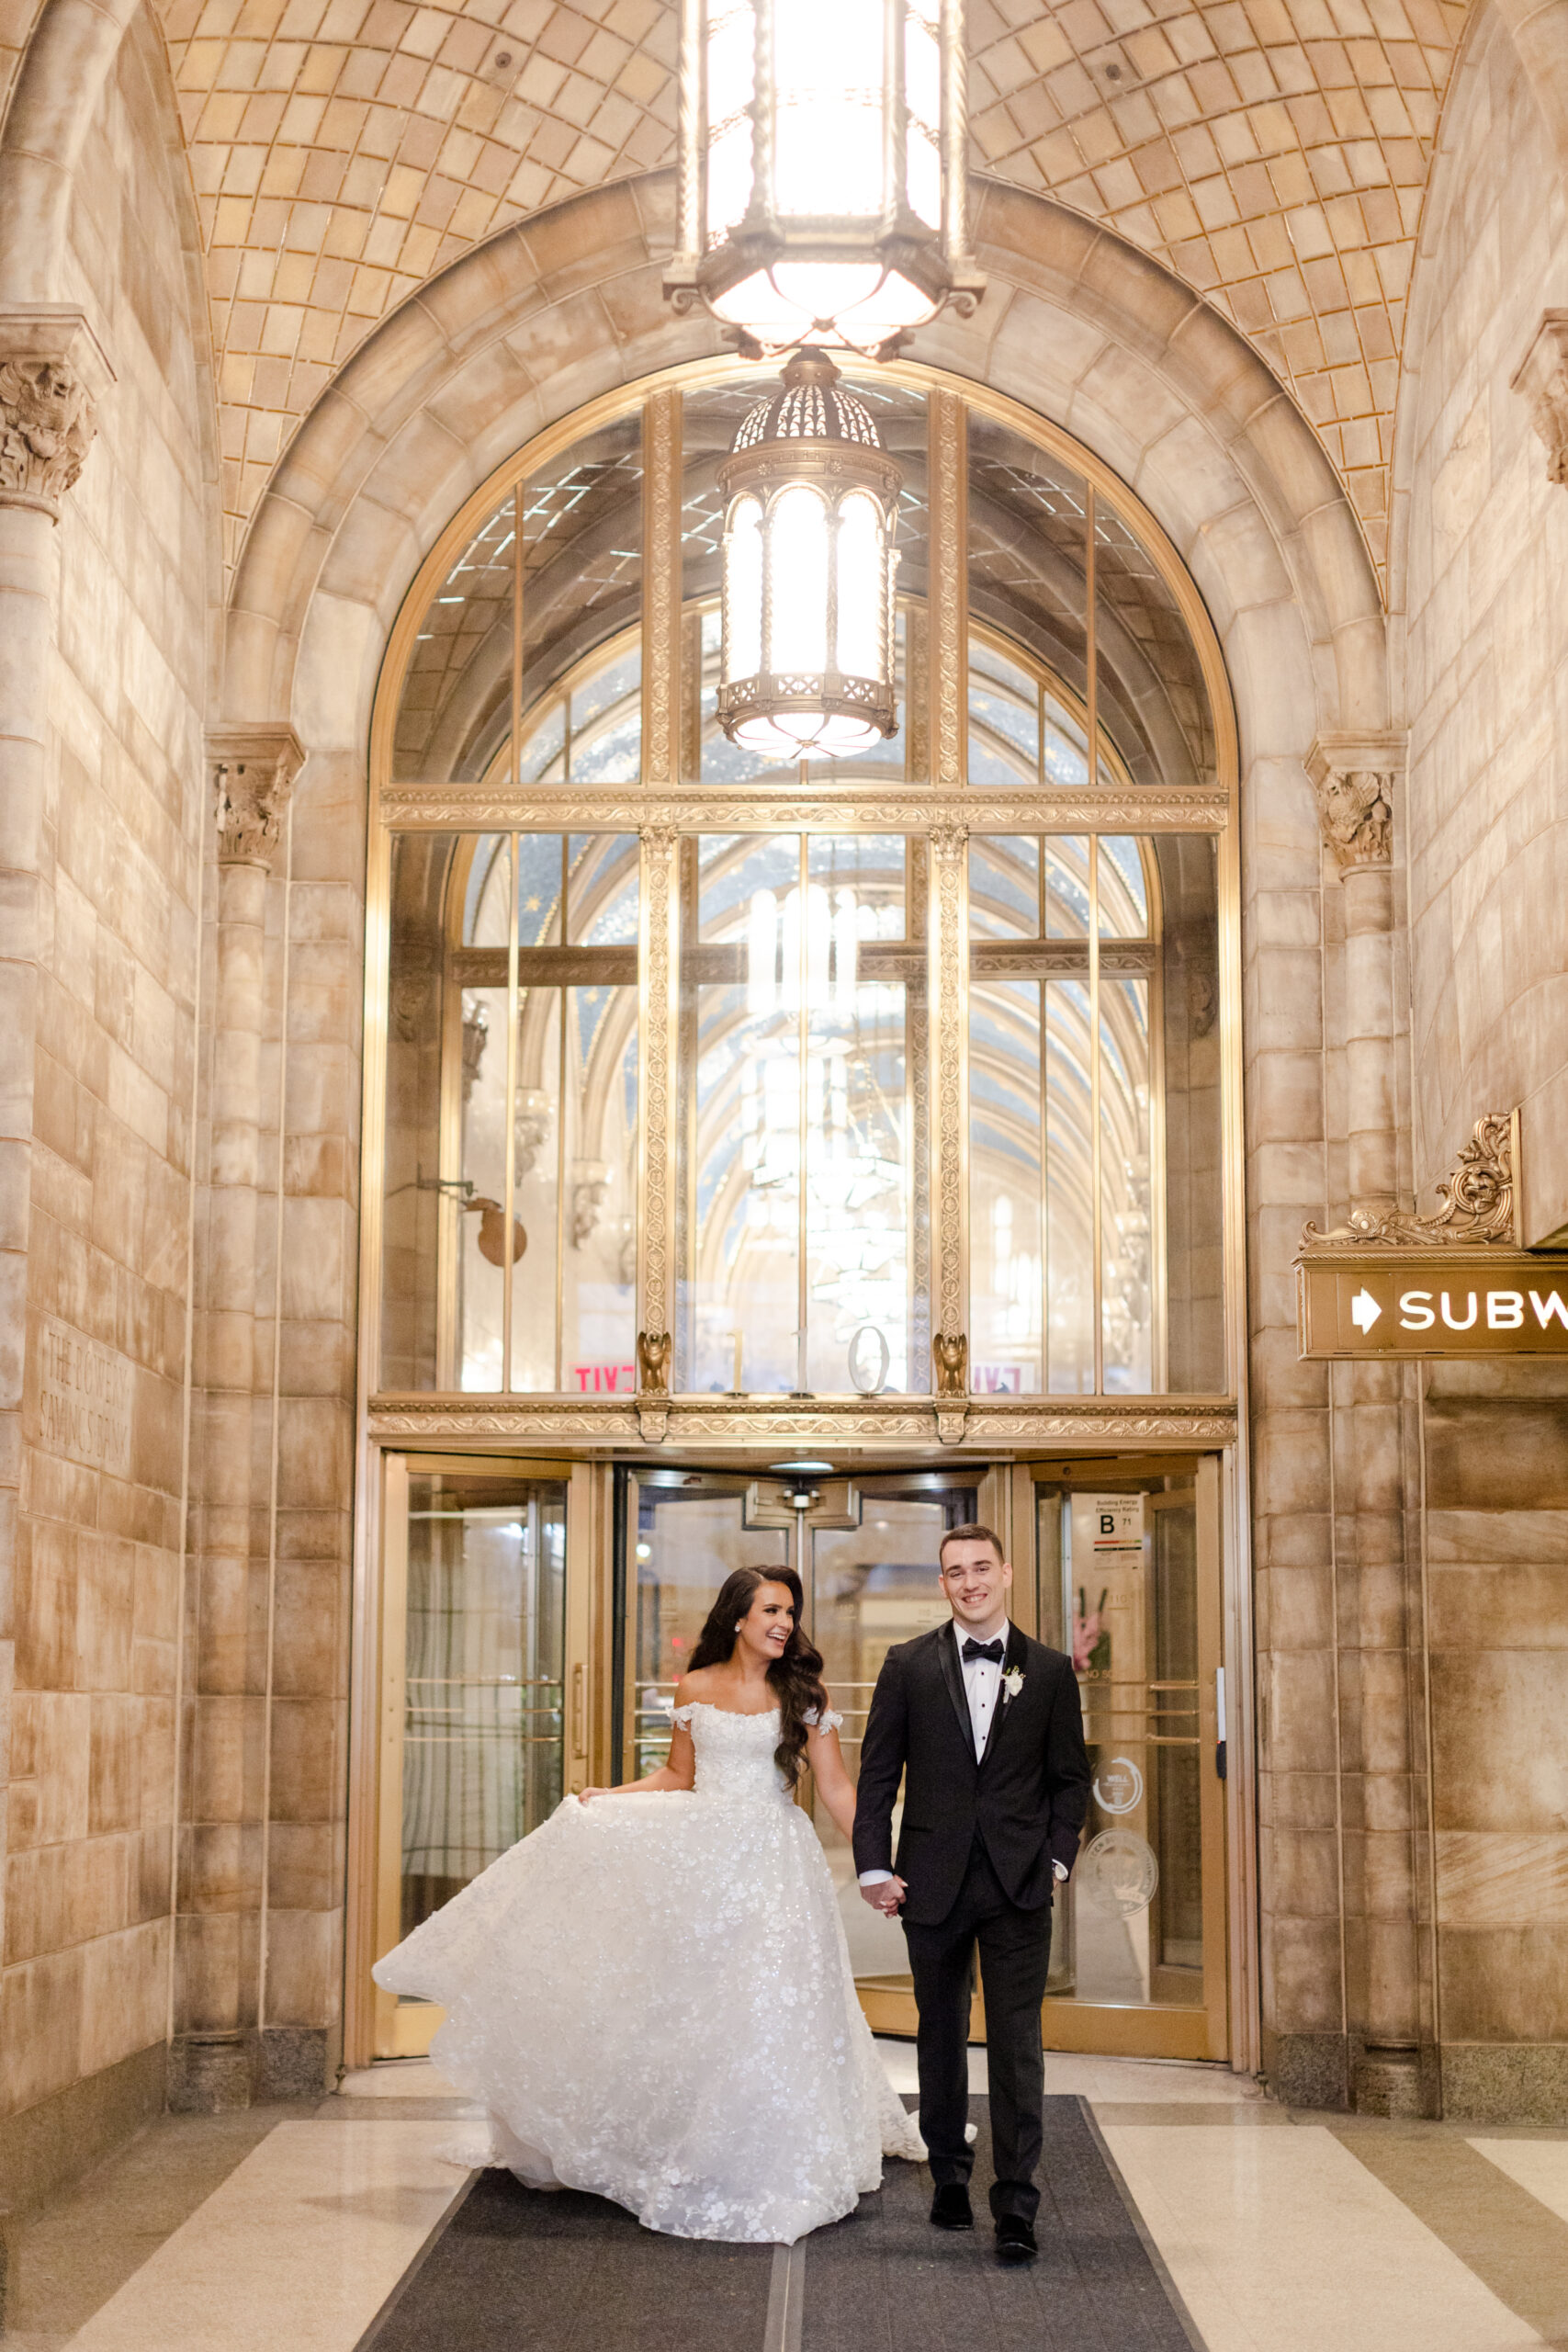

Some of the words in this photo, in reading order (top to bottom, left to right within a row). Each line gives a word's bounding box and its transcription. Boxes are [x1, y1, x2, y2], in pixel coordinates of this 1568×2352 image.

[48, 1331, 73, 1386] THE
[39, 1389, 94, 1455] SAVINGS
[1100, 1514, 1115, 1534] B
[1122, 1518, 1132, 1526] 71
